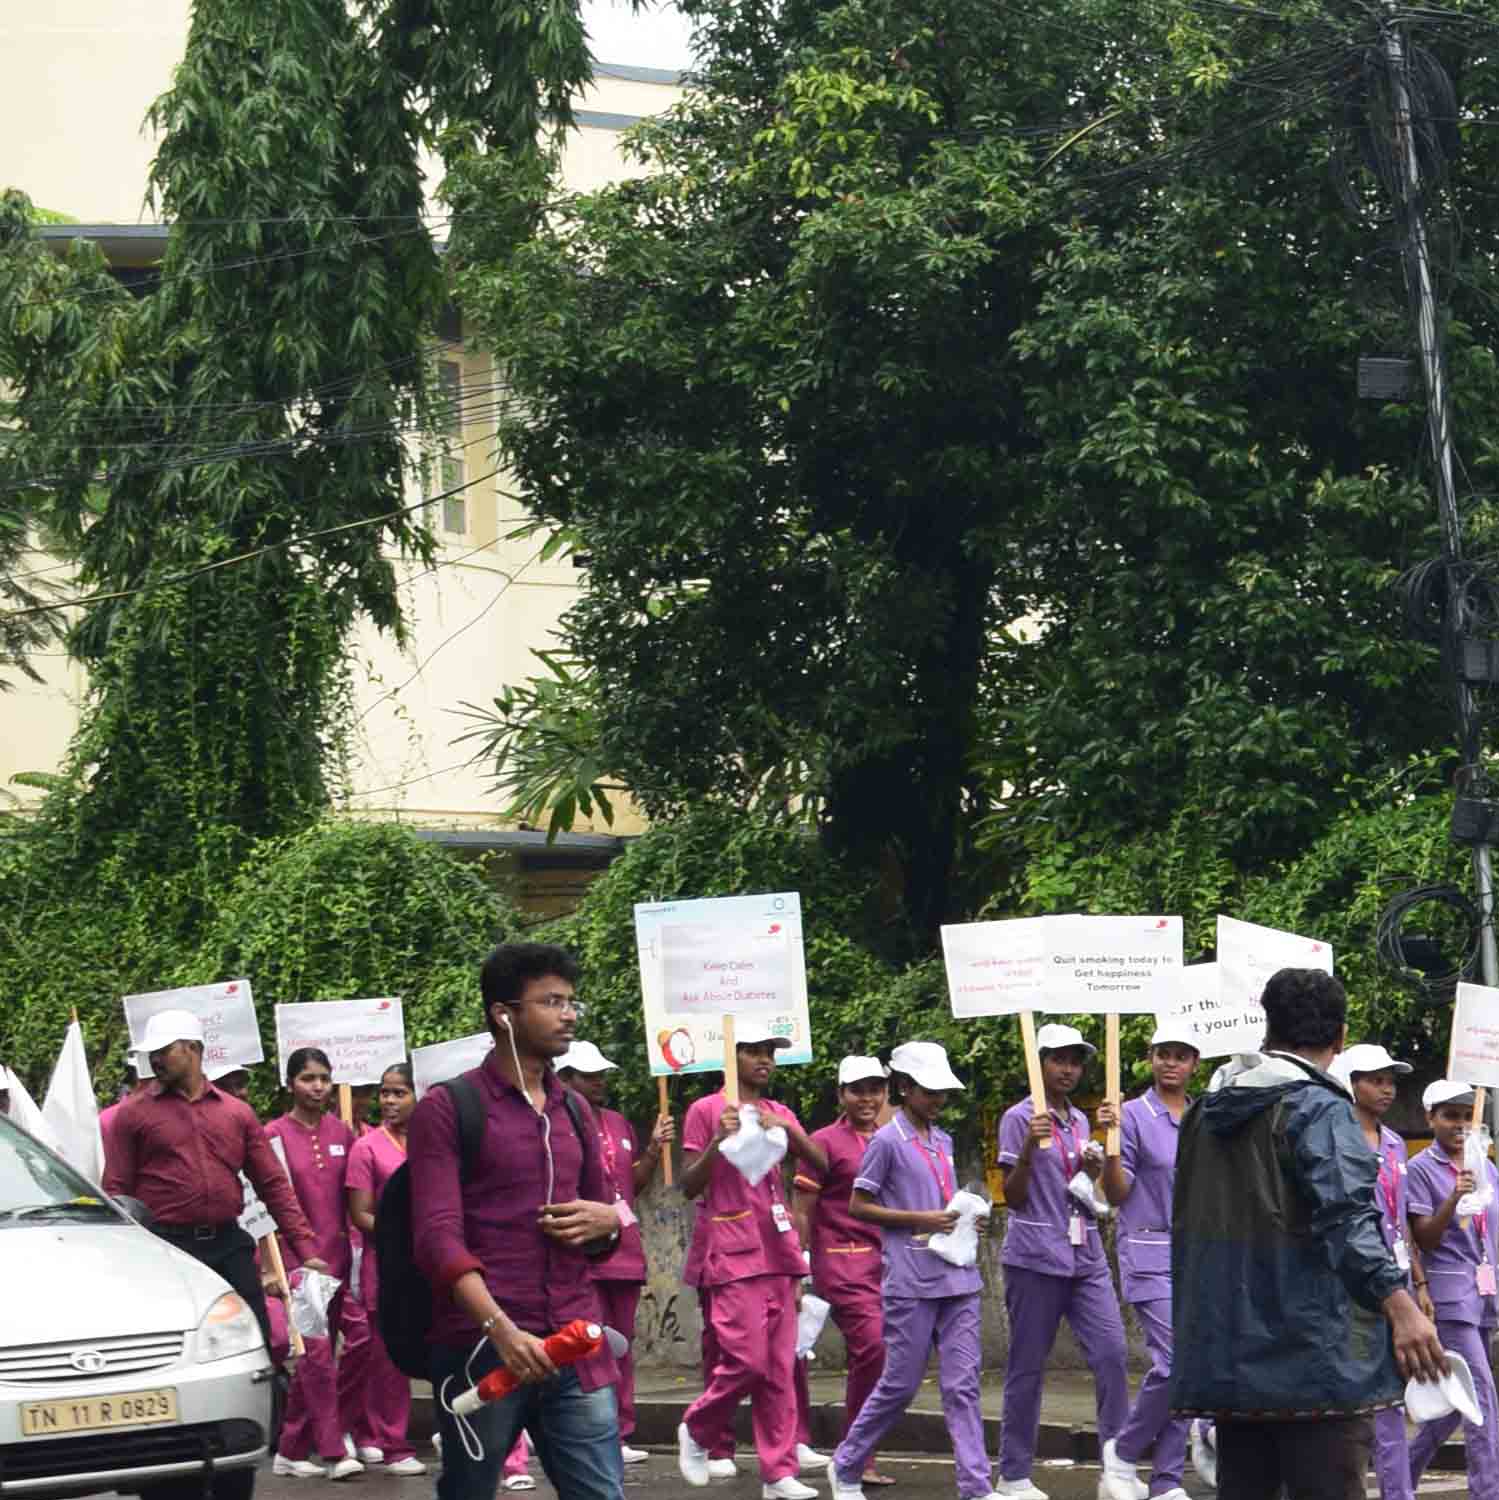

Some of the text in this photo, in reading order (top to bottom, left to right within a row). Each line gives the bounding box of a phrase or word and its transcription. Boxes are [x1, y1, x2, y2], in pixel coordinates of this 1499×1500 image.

[1053, 955, 1076, 965] Quit
[1080, 955, 1125, 966] smoking
[1128, 955, 1159, 966] today
[1074, 969, 1152, 980] Get happiness
[1087, 982, 1141, 991] Tomorrow
[1205, 1018, 1239, 1033] your
[28, 1397, 169, 1429] TN 11 R 0829
